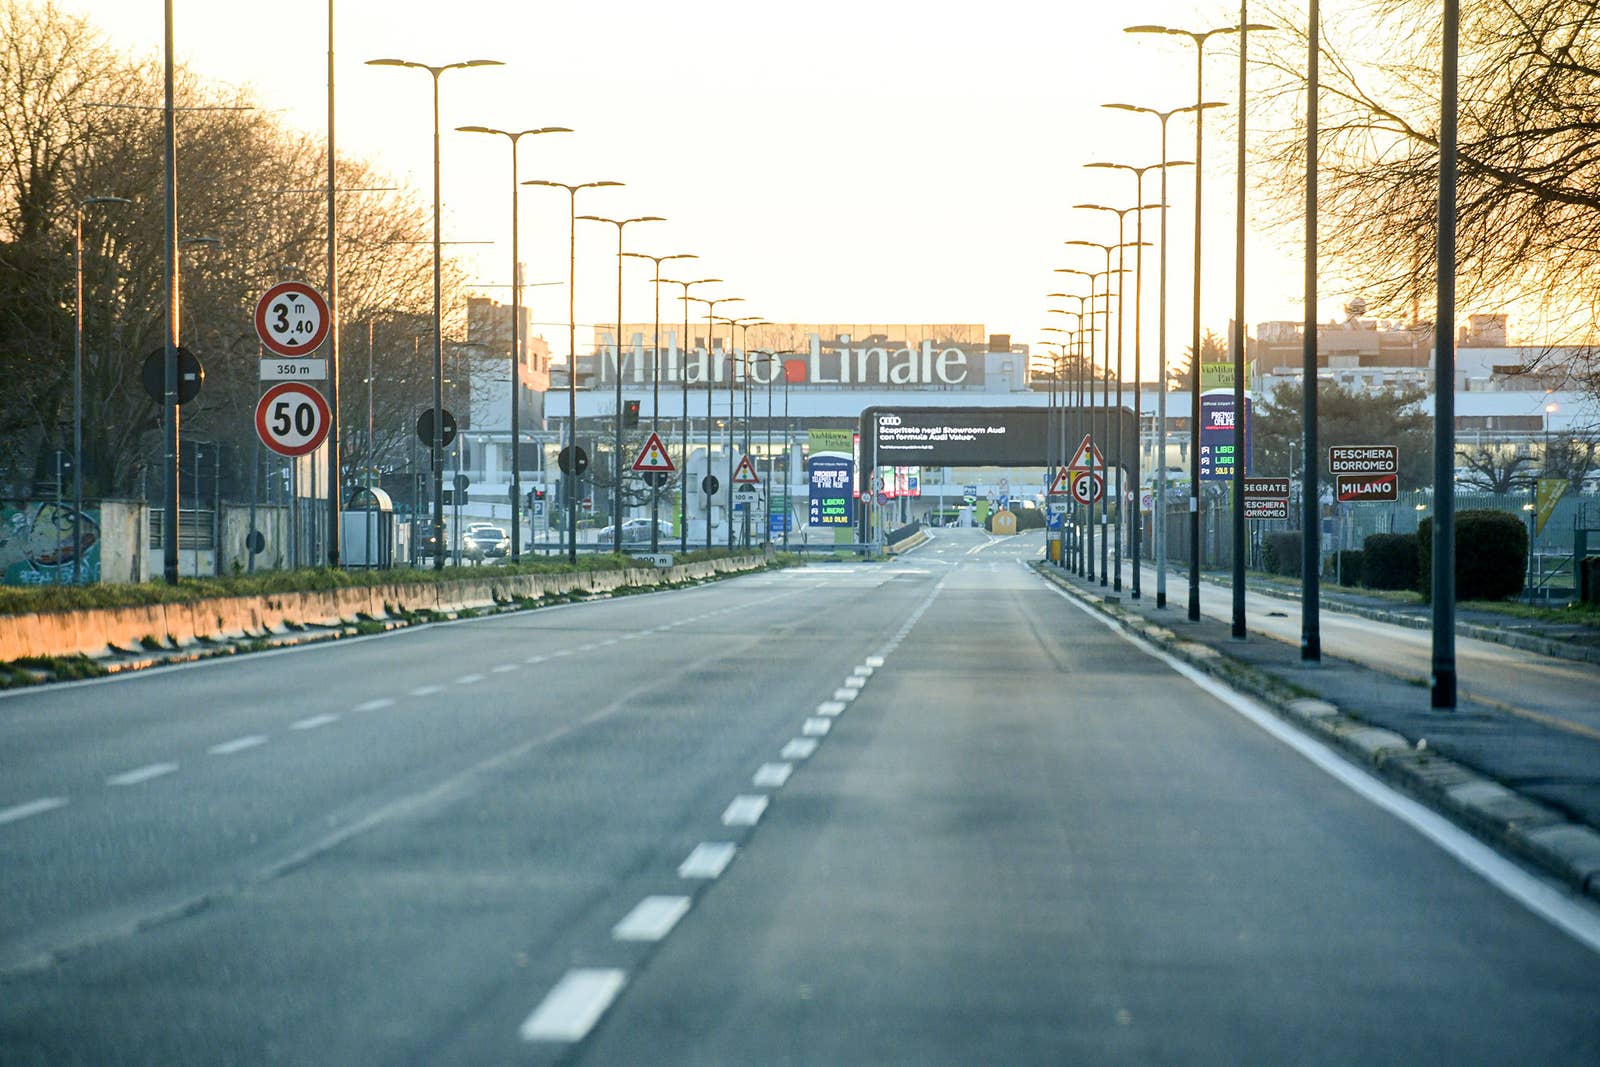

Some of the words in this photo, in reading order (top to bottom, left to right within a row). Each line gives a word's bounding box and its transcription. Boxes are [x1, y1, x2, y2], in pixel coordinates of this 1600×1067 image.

[600, 331, 783, 384] Milano
[808, 333, 968, 384] Linate
[277, 365, 296, 374] 350
[272, 402, 315, 436] 50
[921, 426, 942, 435] negli
[942, 426, 986, 434] Showroom
[986, 426, 1006, 434] Audi
[895, 433, 928, 441] formula
[928, 433, 948, 441] Audi
[1333, 449, 1393, 459] PESCHIERA
[1333, 461, 1394, 470] BORROMEO
[1244, 484, 1287, 492] SEGRATE
[1341, 482, 1392, 494] MILANO
